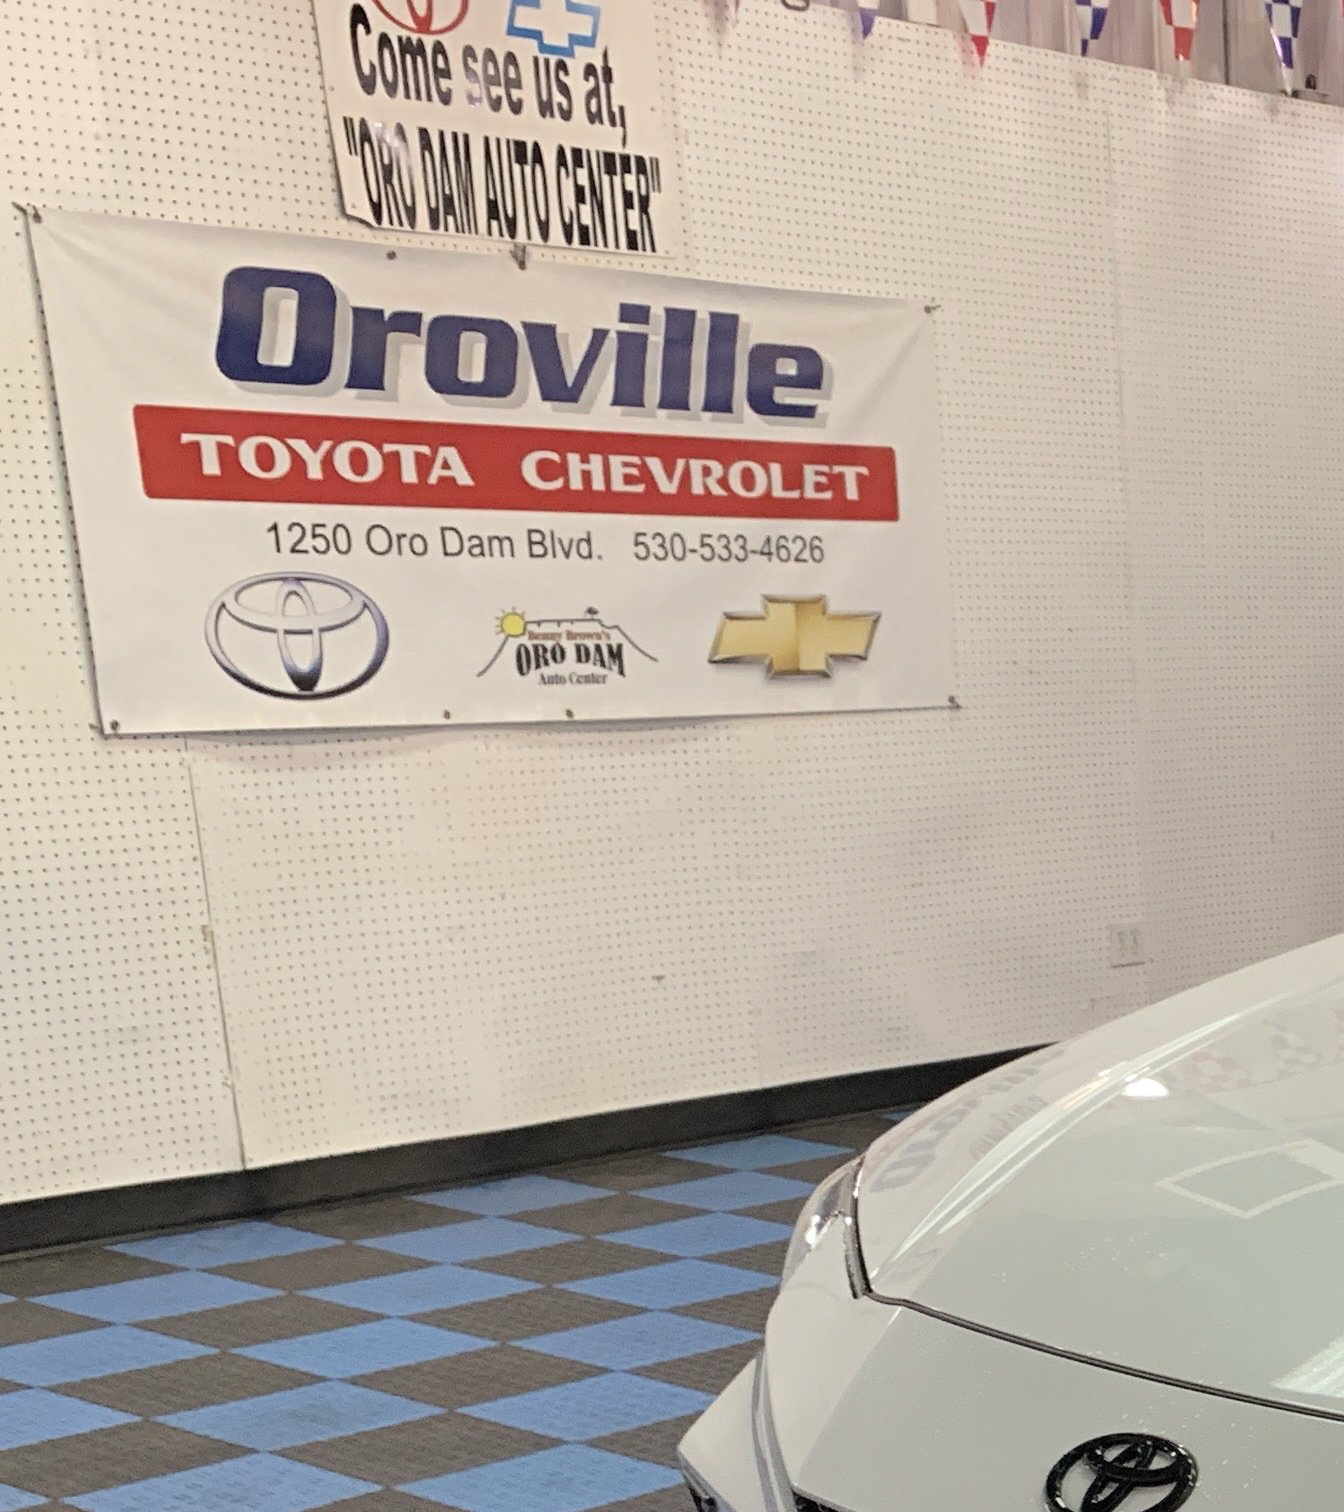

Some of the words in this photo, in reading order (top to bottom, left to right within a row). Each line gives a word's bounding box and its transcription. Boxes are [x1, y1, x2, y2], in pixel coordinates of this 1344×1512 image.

[349, 3, 453, 106] Come
[461, 44, 524, 115] see
[532, 55, 574, 122] us
[417, 126, 479, 235] DAM
[483, 136, 550, 243] AUTO
[555, 144, 661, 253] CENTER"
[215, 265, 826, 421] Oroville
[180, 432, 475, 487] TOYOTA
[520, 449, 870, 501] CHEVROLET
[266, 521, 351, 555] 1250
[366, 524, 428, 557] Oro
[440, 526, 515, 559] Dam
[527, 528, 603, 562] Blvd.
[632, 531, 825, 564] 530-533-4626
[515, 642, 566, 677] ORO
[574, 642, 626, 678] DAM
[539, 673, 567, 686] Auto
[568, 672, 609, 686] Center
